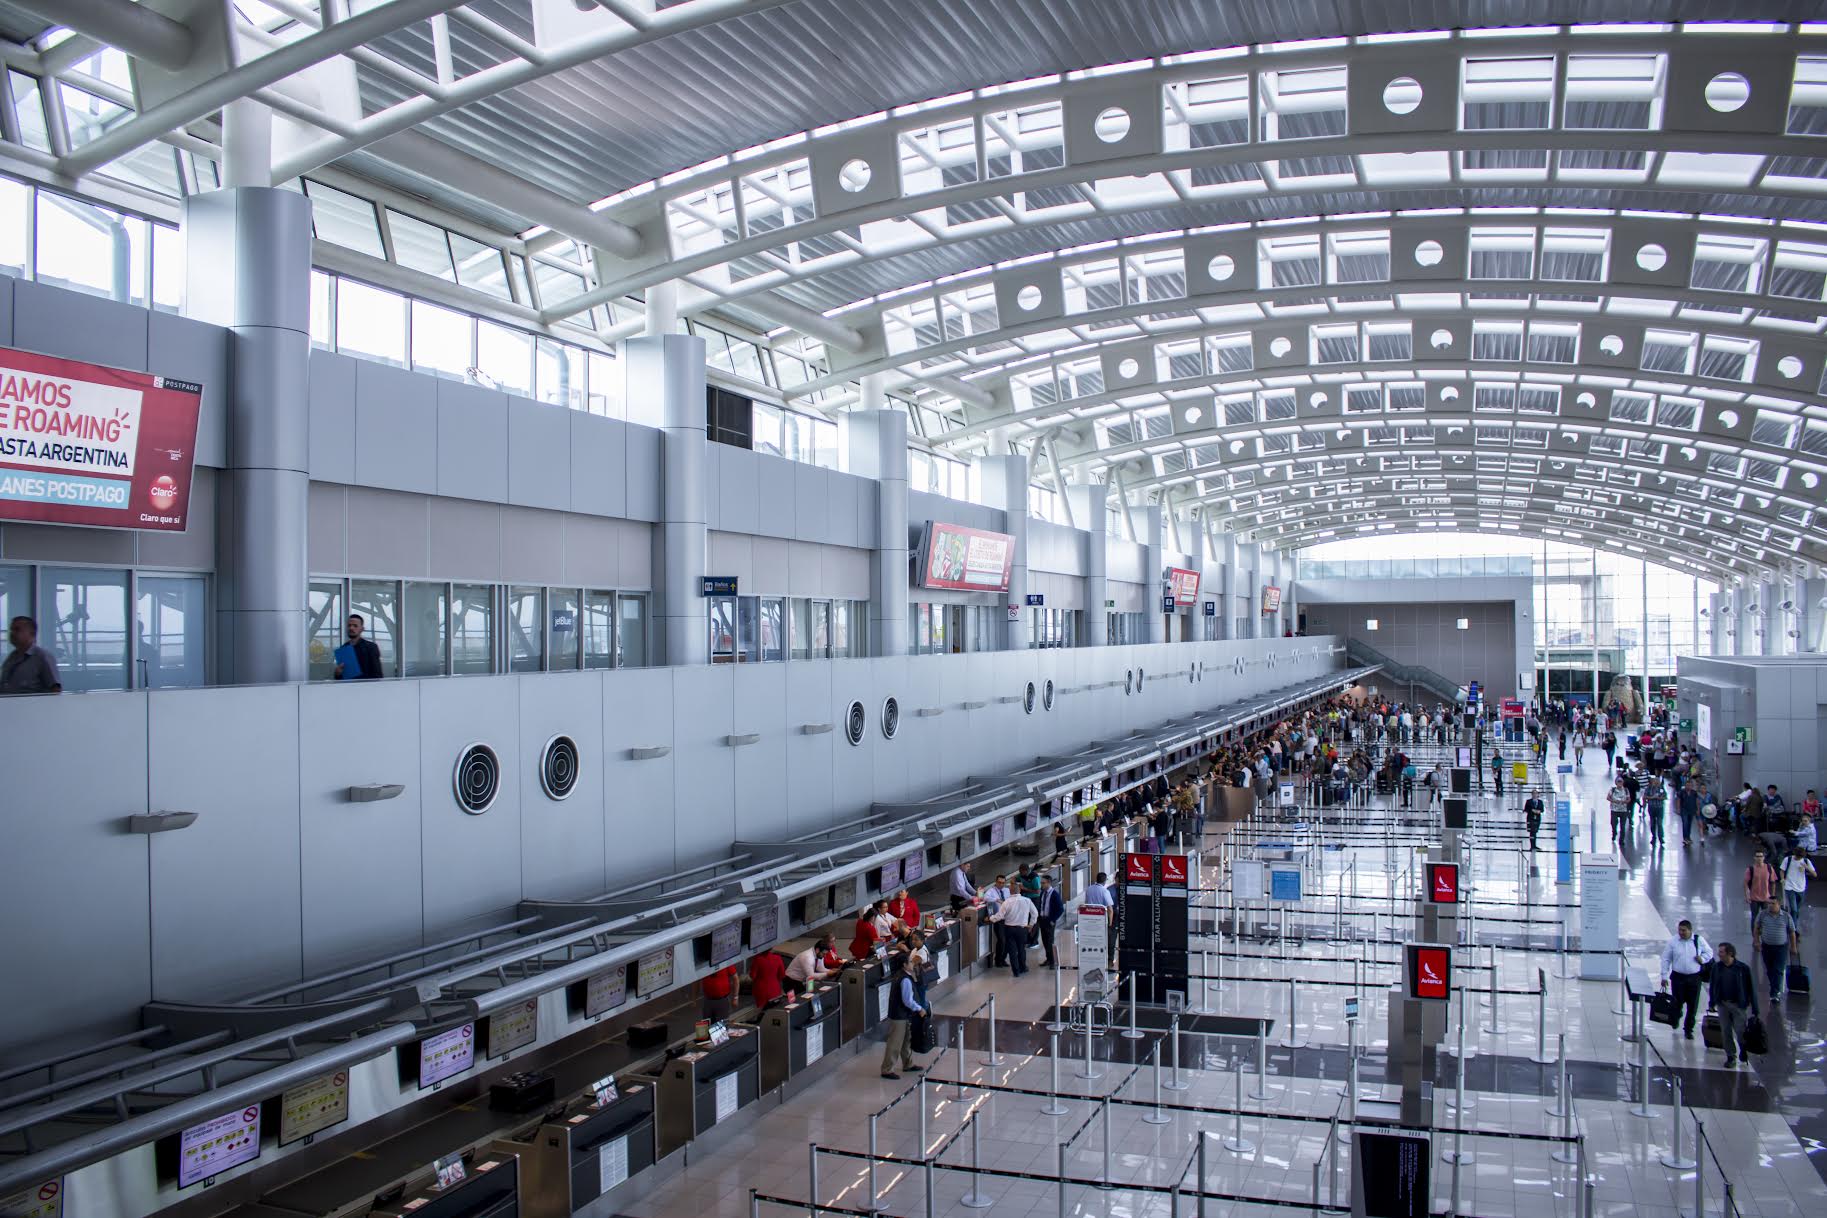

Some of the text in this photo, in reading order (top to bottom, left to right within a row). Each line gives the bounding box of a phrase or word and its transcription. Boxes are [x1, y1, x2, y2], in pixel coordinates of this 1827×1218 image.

[0, 373, 72, 409] AMOS
[165, 380, 199, 392] POSTPAGO
[13, 405, 121, 443] ROAMING
[39, 442, 129, 469] ARGENTINA
[47, 480, 125, 504] POSTPAGO
[151, 486, 174, 497] Claro
[140, 513, 159, 522] Claro
[160, 516, 173, 525] que
[554, 615, 572, 627] jetBlue
[1421, 977, 1443, 985] Avianca
